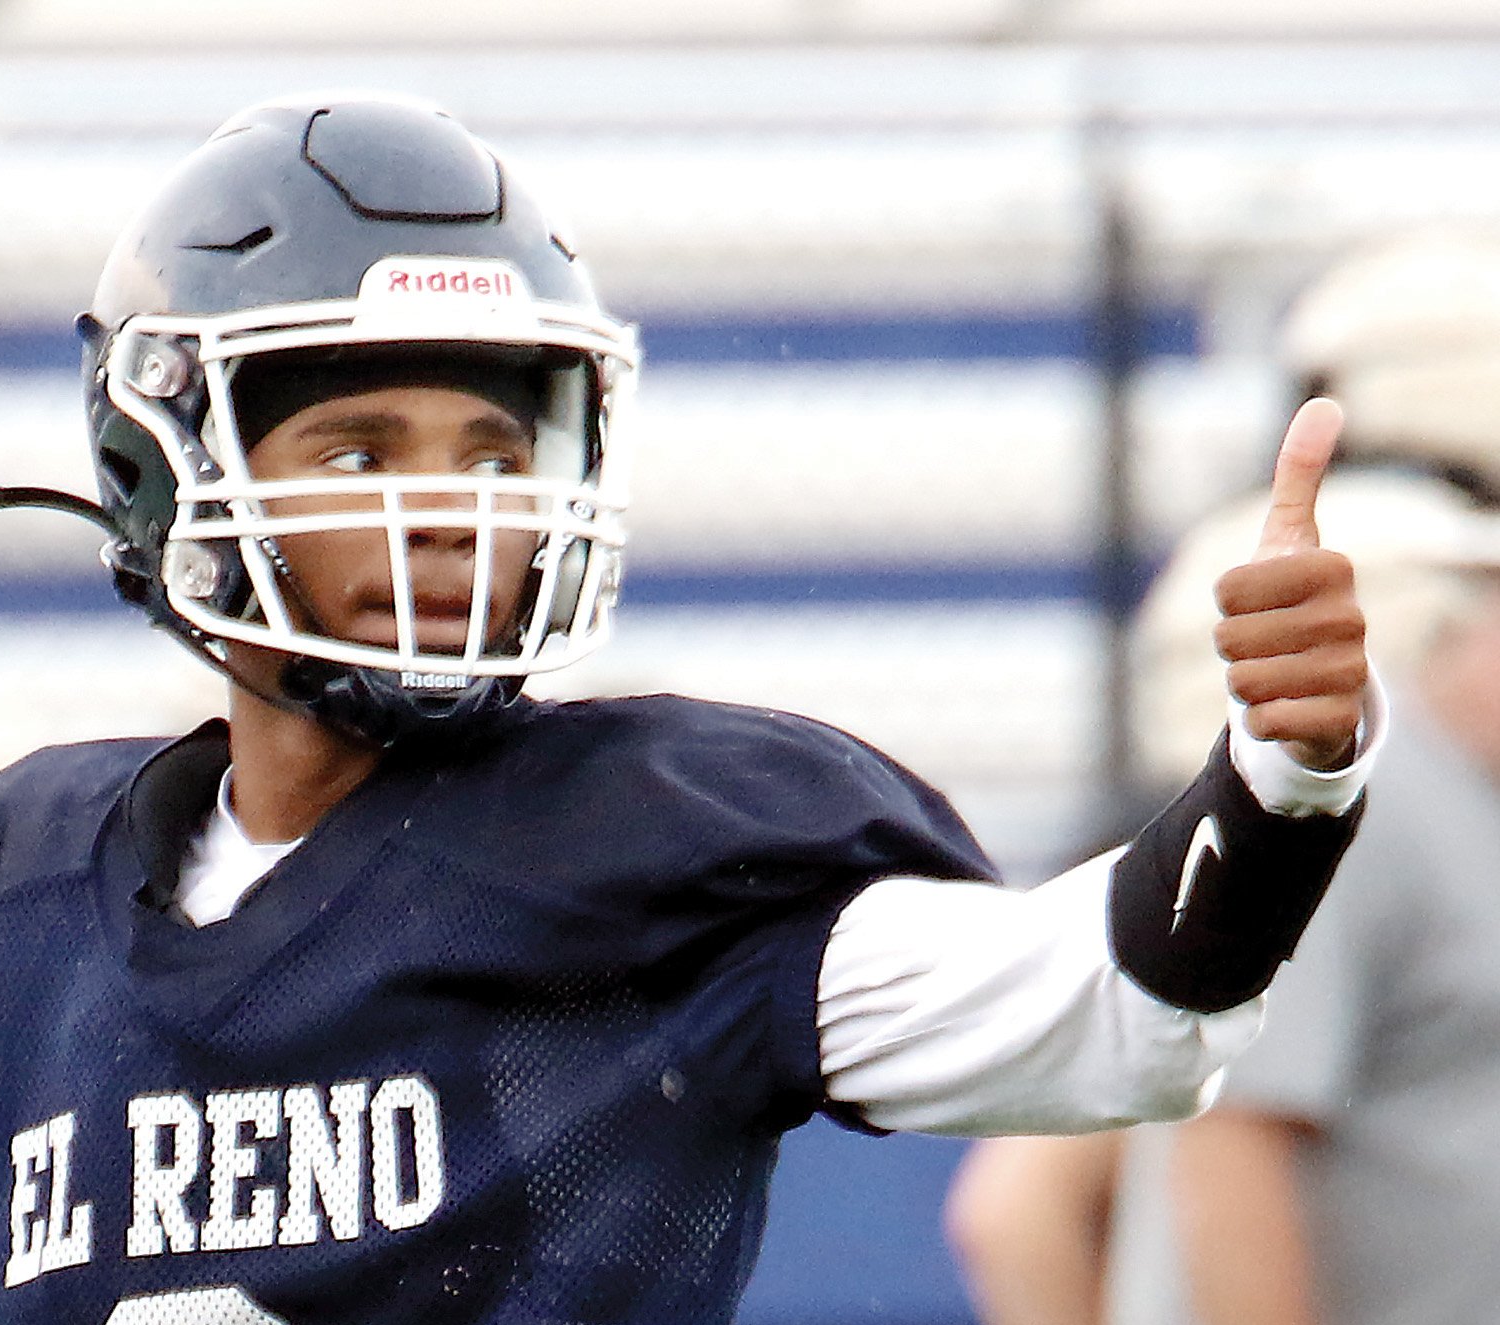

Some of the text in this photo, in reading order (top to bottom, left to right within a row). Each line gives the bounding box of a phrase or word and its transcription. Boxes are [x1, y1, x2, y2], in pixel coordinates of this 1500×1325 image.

[387, 269, 512, 297] Riddell
[401, 671, 467, 688] Riddell
[4, 1075, 445, 1289] EL RENO
